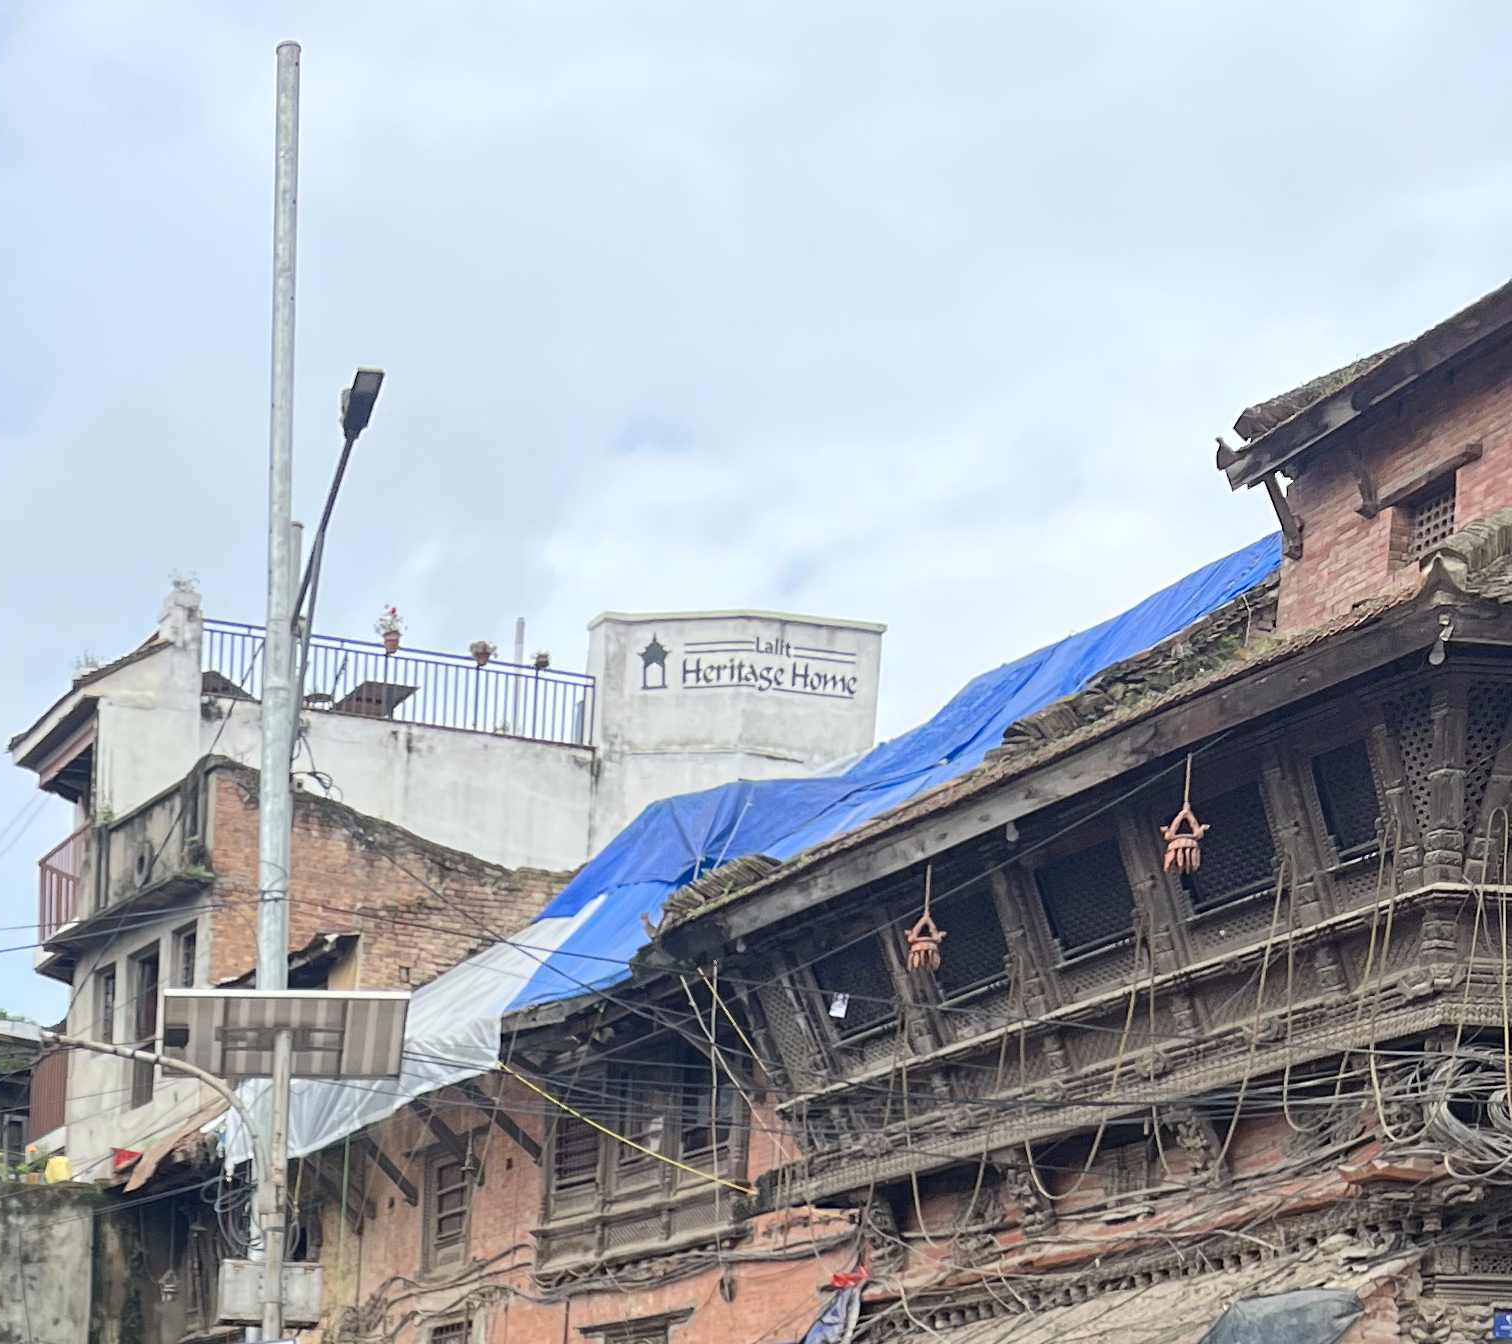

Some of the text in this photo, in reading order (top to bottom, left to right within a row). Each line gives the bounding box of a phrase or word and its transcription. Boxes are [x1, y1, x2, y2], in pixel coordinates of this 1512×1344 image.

[754, 636, 791, 658] Lalit
[683, 657, 857, 695] Heritage Home
